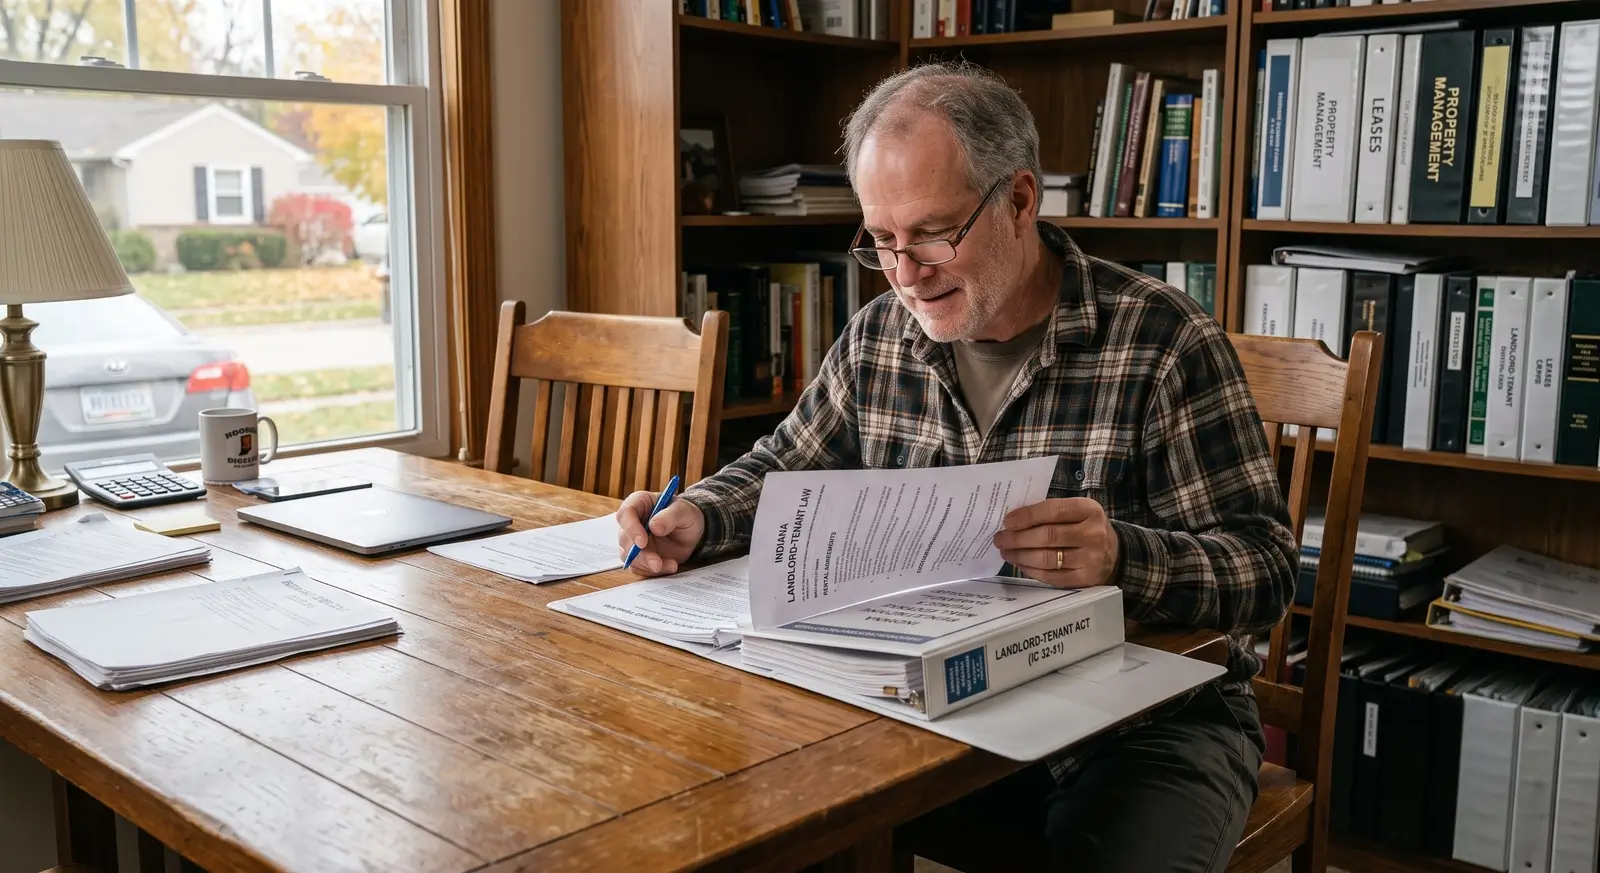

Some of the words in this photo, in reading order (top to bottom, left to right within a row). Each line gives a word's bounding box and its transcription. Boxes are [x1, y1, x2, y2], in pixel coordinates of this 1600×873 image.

[1312, 92, 1326, 169] MANAGEMENT
[1325, 100, 1337, 158] PROPERTY
[1369, 97, 1385, 153] LEASES
[1427, 76, 1447, 182] MANAGEMENT
[1442, 87, 1460, 167] PROPERTY
[1505, 327, 1519, 408] LANDLORD-TENANT
[1544, 358, 1553, 388] LEASES
[775, 523, 789, 564] INDIANA
[788, 509, 806, 604] LANDLORD-TENANT
[799, 488, 812, 508] LAW
[995, 623, 1074, 661] LANDLORD-TENANT
[1074, 617, 1091, 633] ACT
[1028, 651, 1040, 667] (IC
